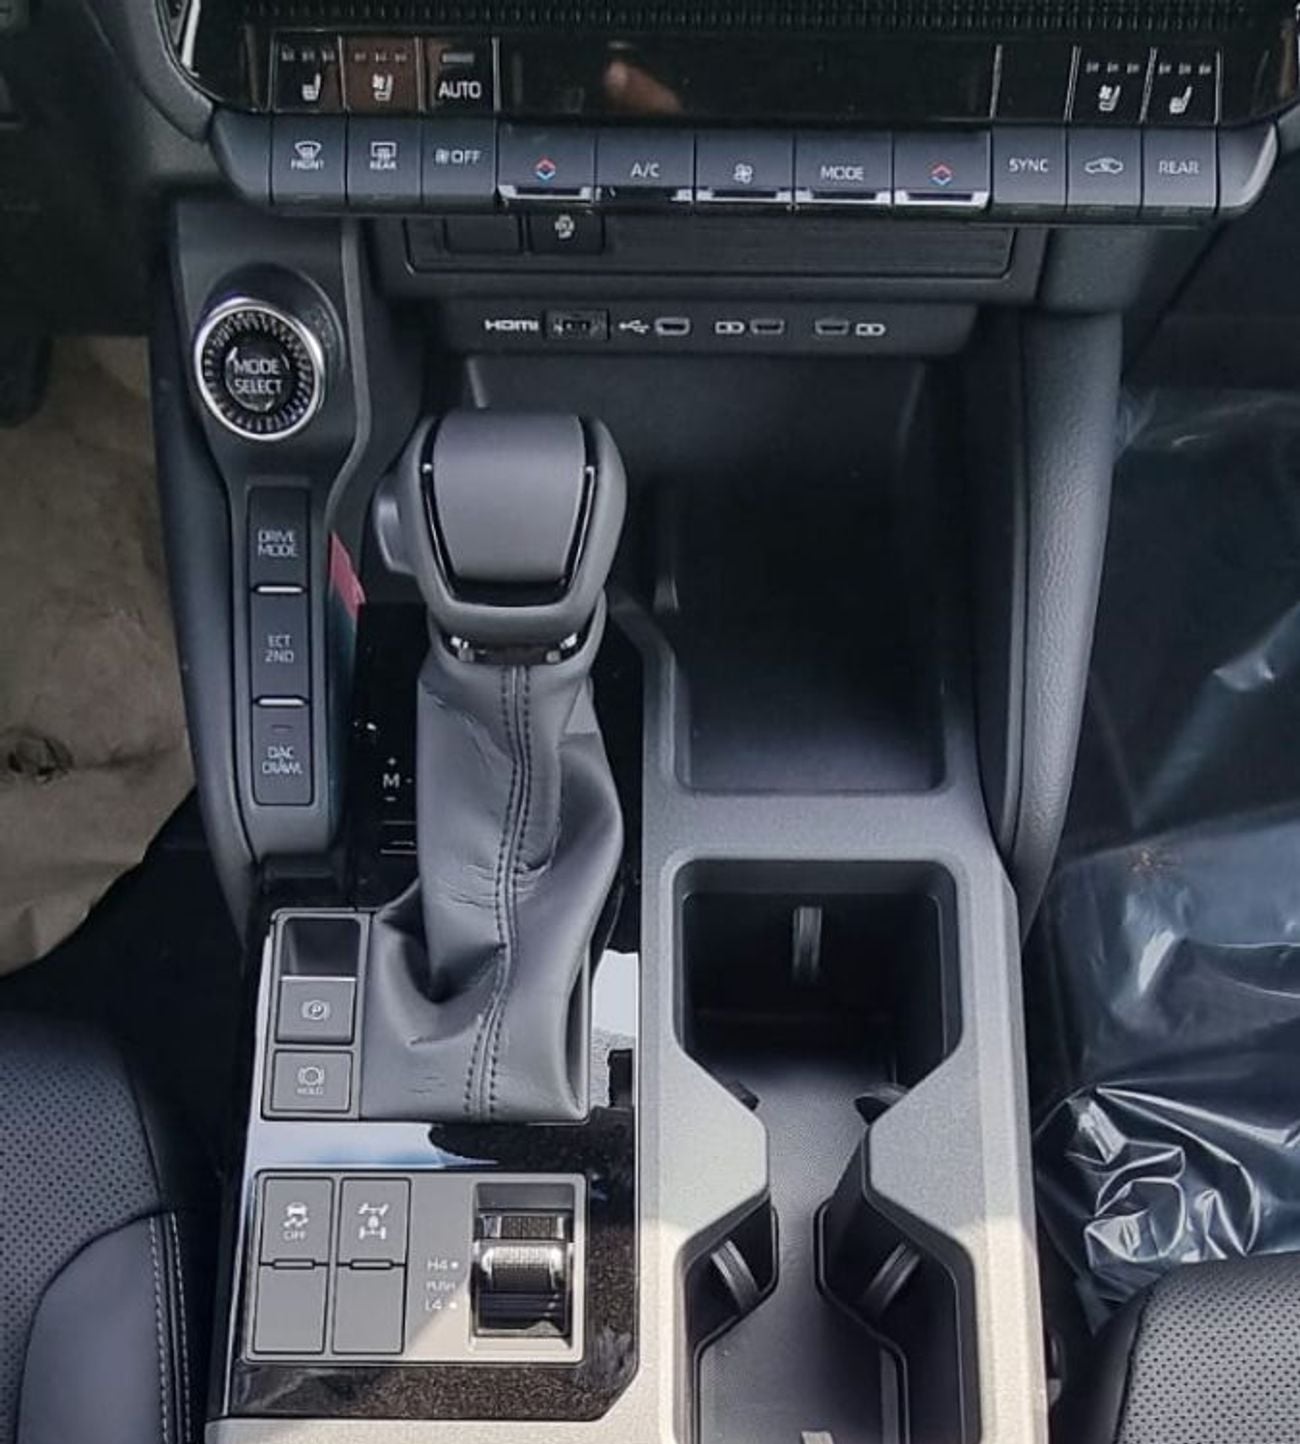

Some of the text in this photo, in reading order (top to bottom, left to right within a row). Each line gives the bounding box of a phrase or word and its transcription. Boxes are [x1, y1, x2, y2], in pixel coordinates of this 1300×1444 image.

[438, 80, 482, 99] AUTO
[451, 149, 481, 164] OFF
[631, 163, 660, 178] A/C
[820, 165, 864, 181] MODE
[1008, 158, 1049, 173] SYNC
[1158, 160, 1200, 174] REAR
[233, 356, 280, 375] MODE
[234, 378, 283, 396] SELECT
[257, 529, 296, 543] DRIVE
[257, 543, 298, 557] MODE
[267, 634, 291, 648] ECT
[264, 647, 295, 663] 2ND
[267, 746, 294, 760] DAC
[382, 772, 401, 789] M
